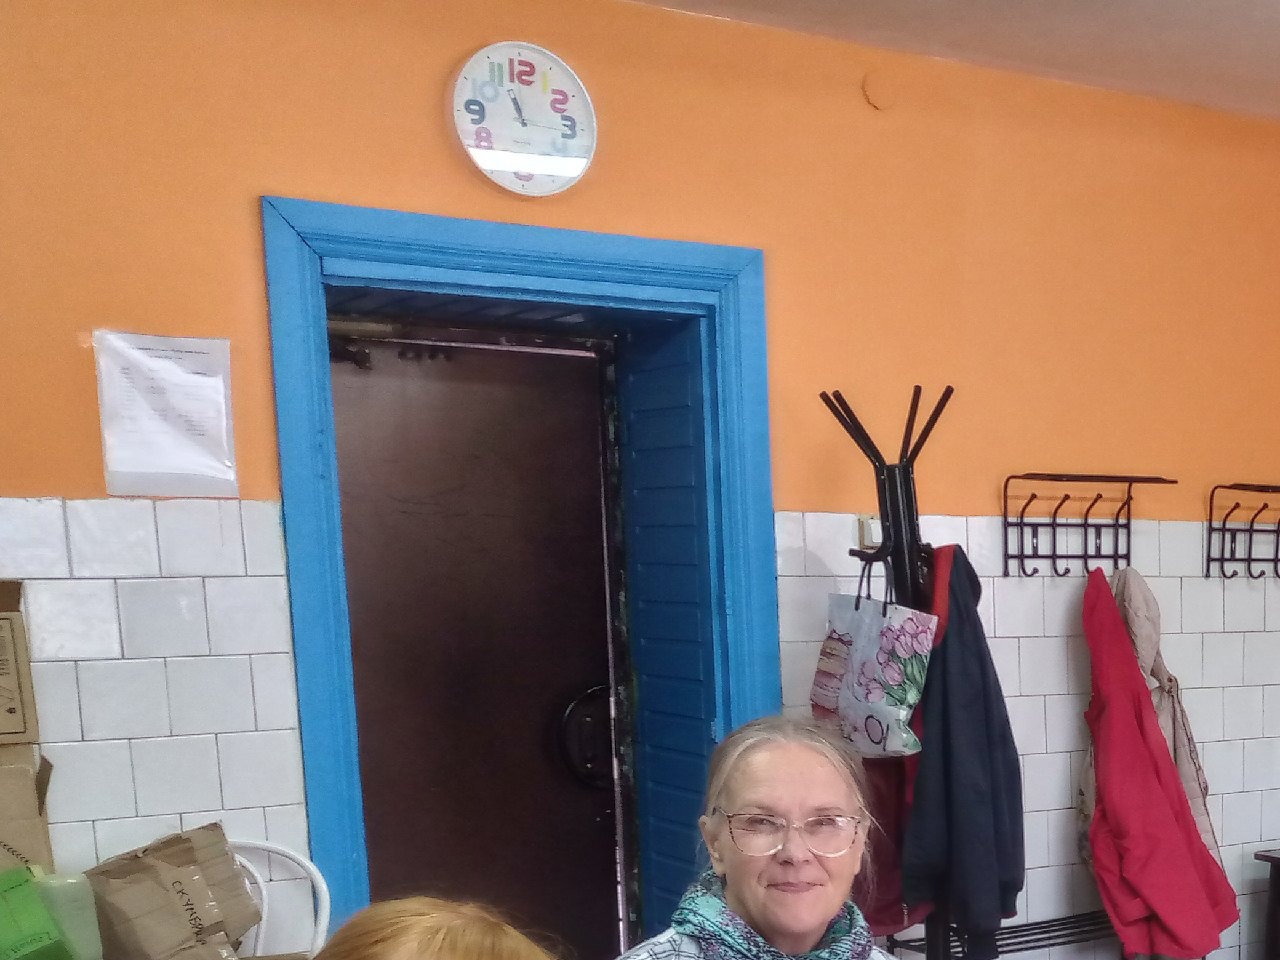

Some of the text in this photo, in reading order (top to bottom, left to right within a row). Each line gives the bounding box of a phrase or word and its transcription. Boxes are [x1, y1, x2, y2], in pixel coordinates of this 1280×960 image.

[488, 61, 504, 88] 11
[508, 57, 536, 86] 12
[463, 98, 487, 126] 9
[549, 88, 570, 114] 2
[560, 114, 578, 140] 3
